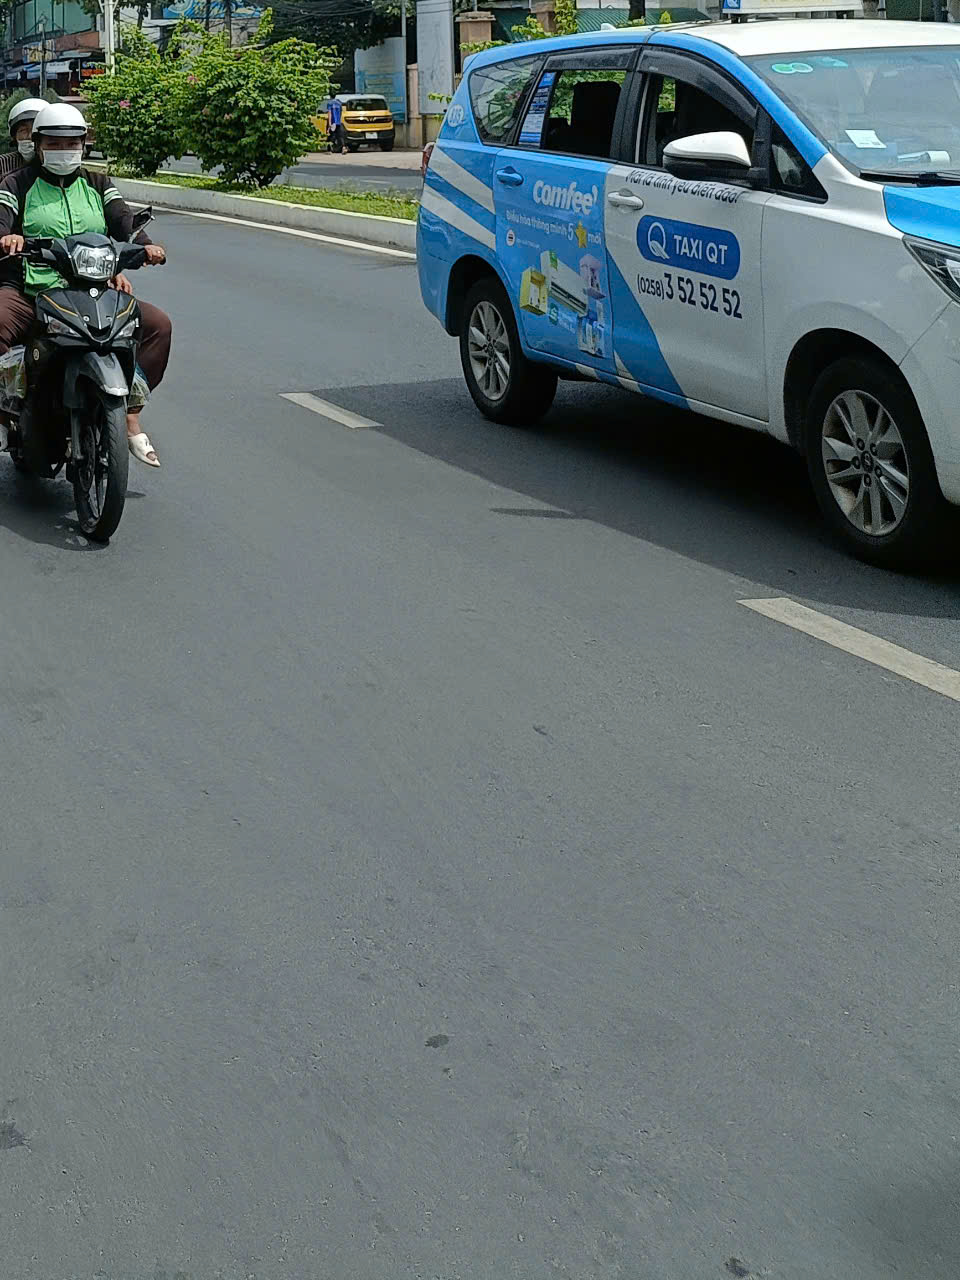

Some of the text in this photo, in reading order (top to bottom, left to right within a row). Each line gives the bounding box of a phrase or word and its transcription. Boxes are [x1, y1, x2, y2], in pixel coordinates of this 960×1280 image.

[567, 222, 575, 241] 5
[673, 234, 728, 265] TAXI QT
[677, 276, 696, 307] 52
[699, 281, 719, 312] 52
[722, 287, 743, 319] 52
